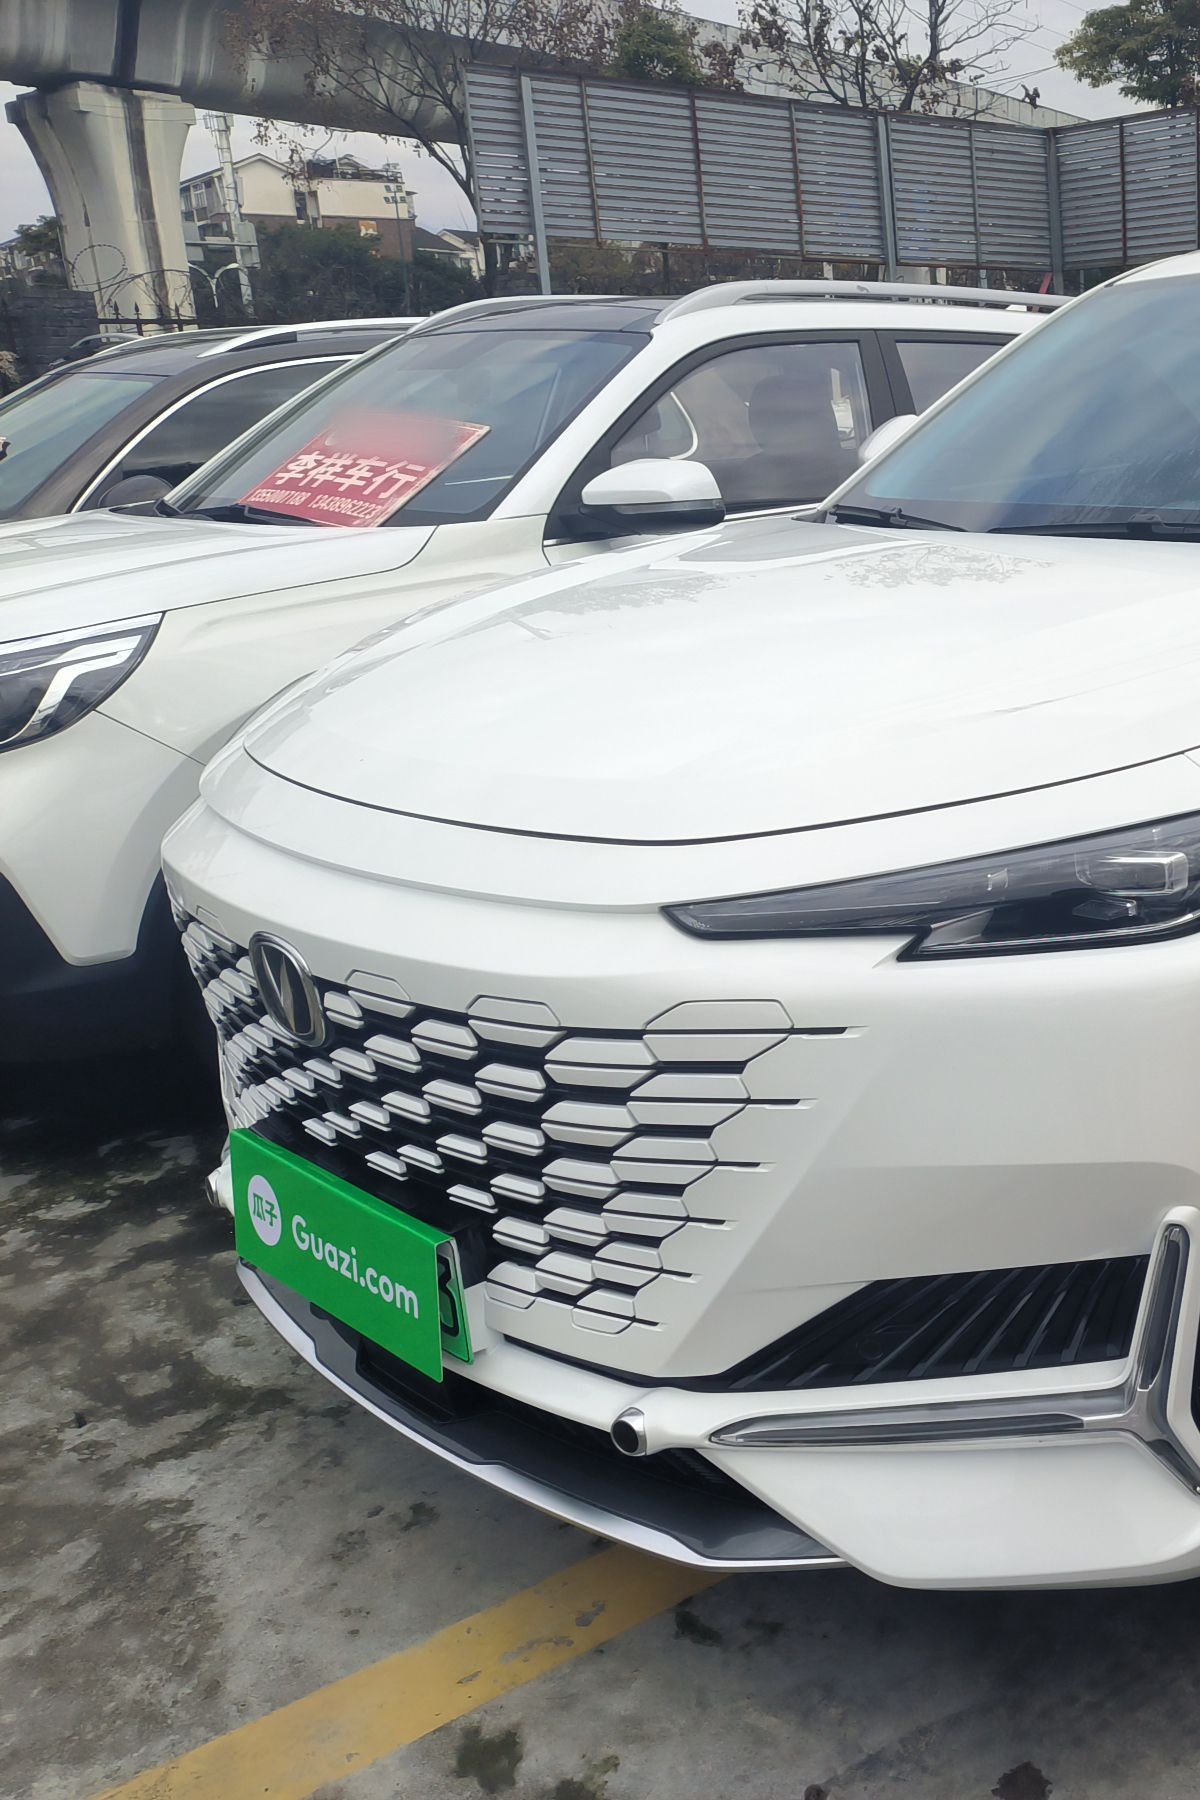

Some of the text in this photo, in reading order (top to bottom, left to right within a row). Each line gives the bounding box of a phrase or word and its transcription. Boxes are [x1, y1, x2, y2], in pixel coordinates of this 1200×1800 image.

[274, 450, 427, 499] 李祥车行
[251, 1192, 278, 1227] 瓜子
[291, 1214, 420, 1319] Guazi.com
